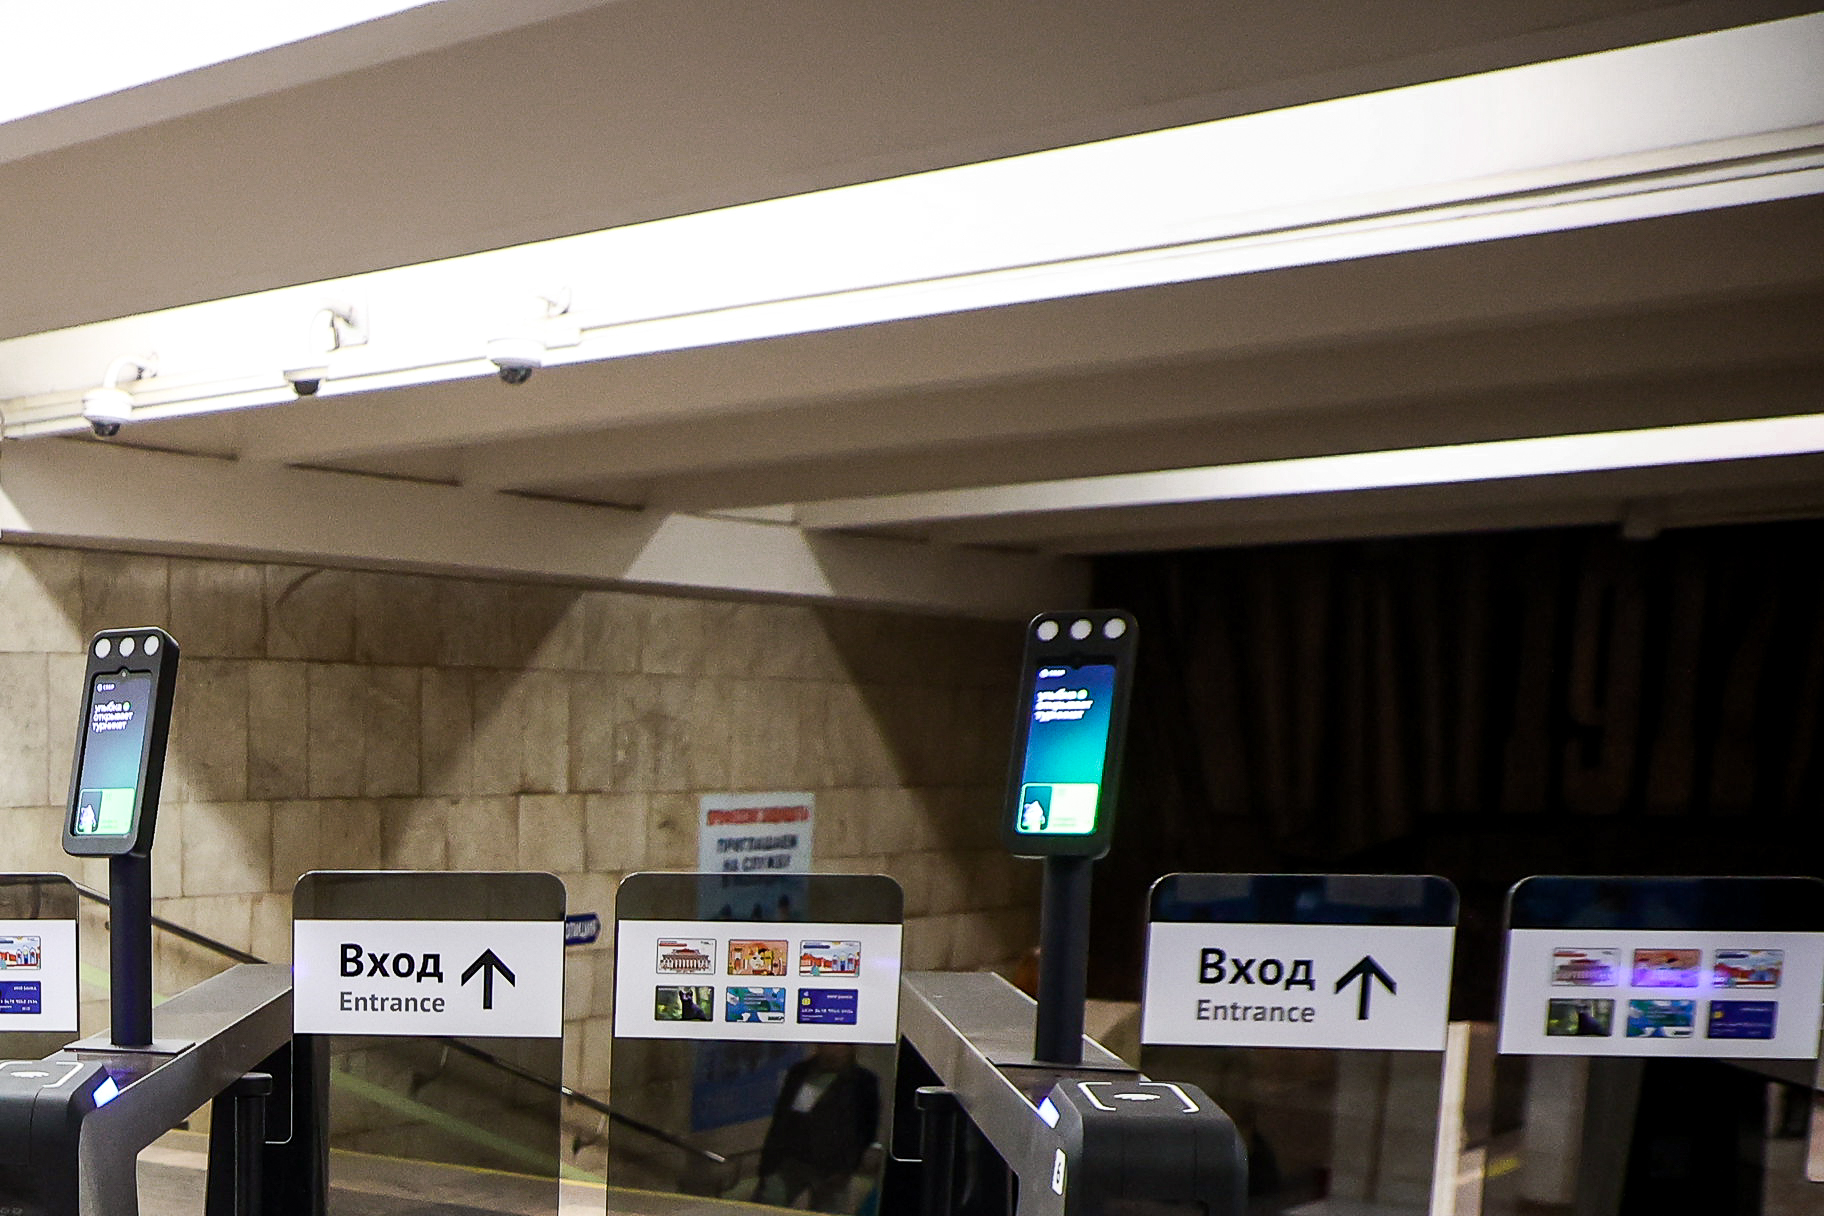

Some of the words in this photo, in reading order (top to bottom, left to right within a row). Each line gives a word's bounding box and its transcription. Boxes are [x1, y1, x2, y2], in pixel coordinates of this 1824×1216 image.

[340, 943, 444, 984] Вход
[1198, 947, 1316, 992] Вход
[339, 991, 446, 1013] Entrance
[1196, 999, 1316, 1024] Entrance
